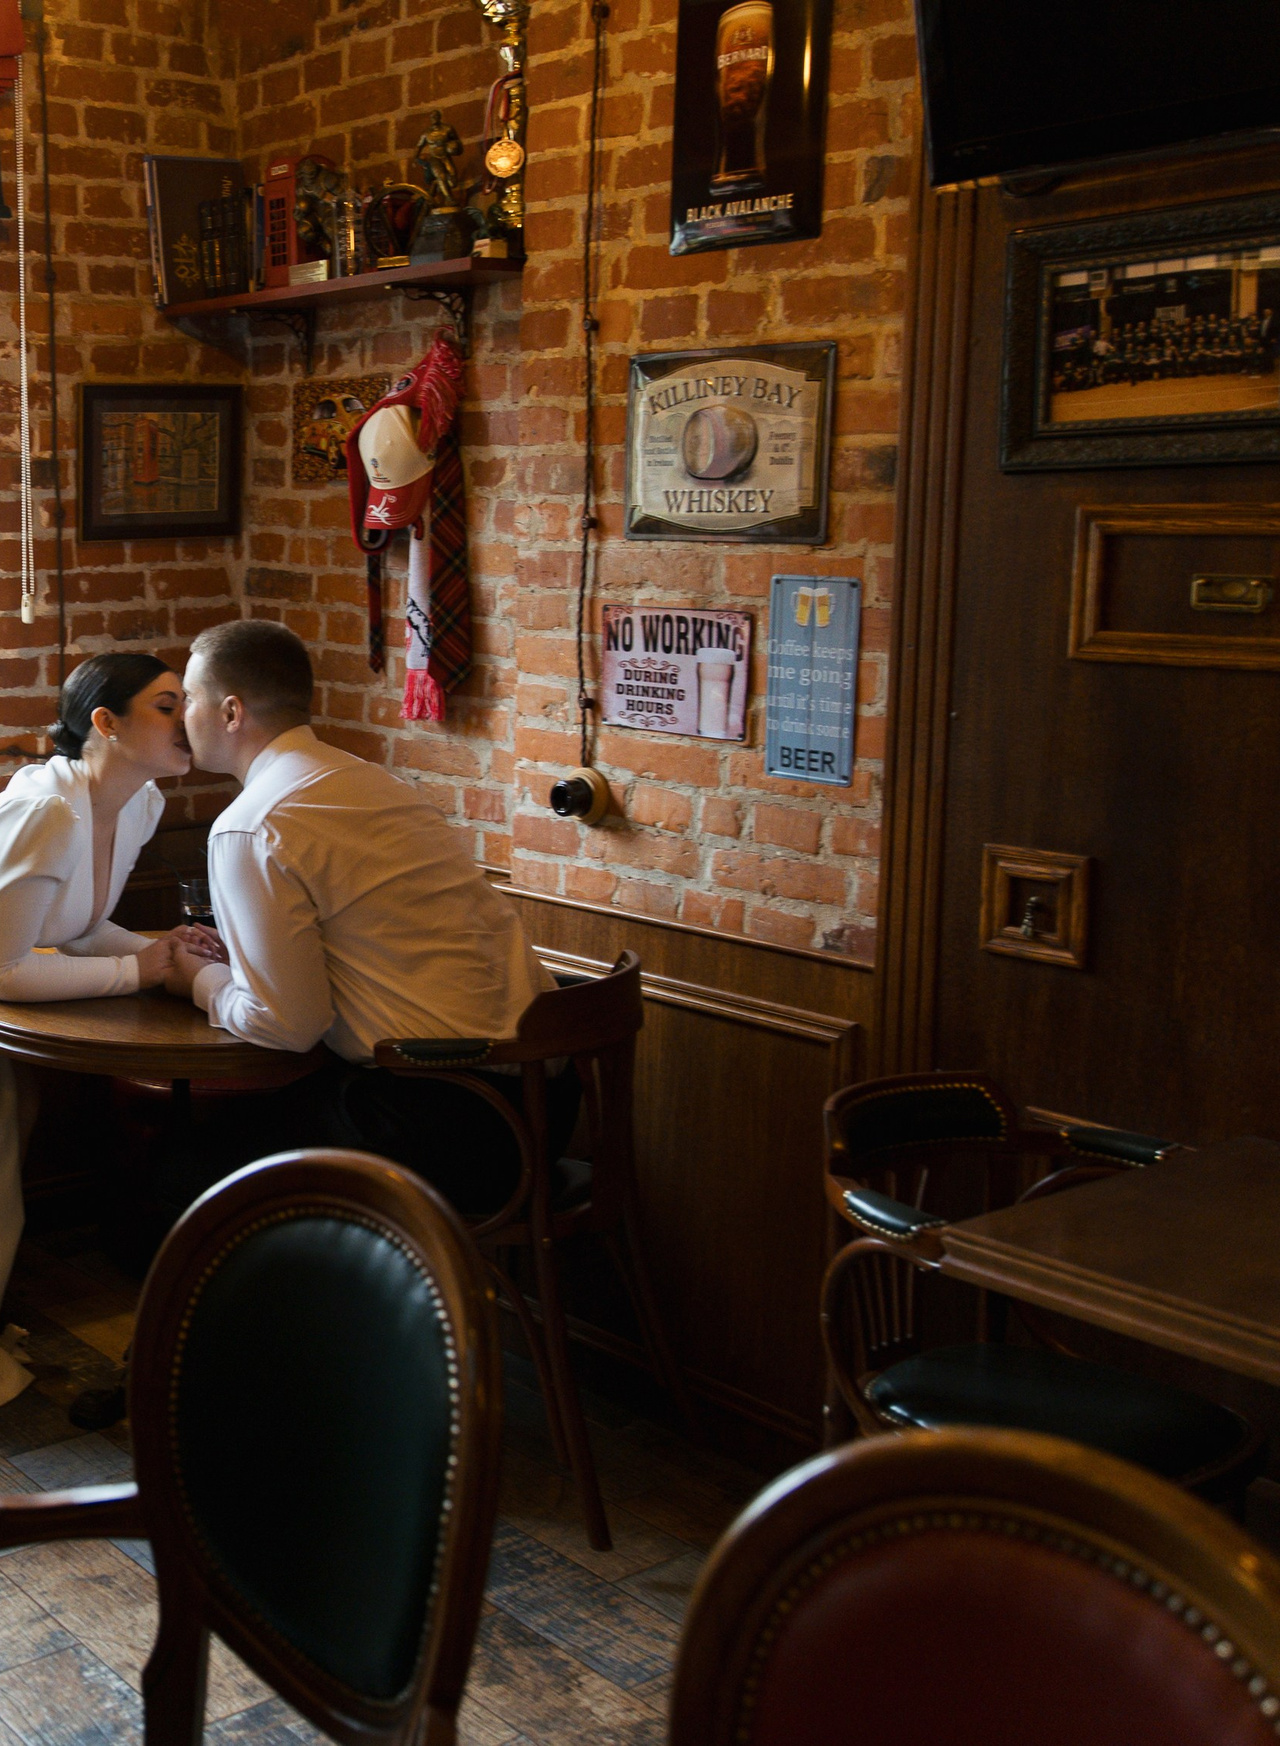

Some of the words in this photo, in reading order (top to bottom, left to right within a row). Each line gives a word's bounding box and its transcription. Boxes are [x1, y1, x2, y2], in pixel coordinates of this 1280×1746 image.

[686, 204, 722, 223] BLACK
[724, 193, 794, 217] AVALANCHE
[649, 376, 747, 415] KILLINEY
[753, 378, 802, 408] BAY
[663, 489, 774, 513] WHISKEY
[605, 616, 634, 652] NO
[641, 614, 746, 662] WORKING
[767, 639, 810, 657] Coffee
[812, 641, 853, 664] keeps
[624, 669, 678, 685] DURING
[767, 665, 796, 680] me
[799, 666, 852, 690] going
[616, 683, 686, 701] DRINKING
[626, 699, 674, 715] HOURS
[780, 746, 836, 774] BEER
